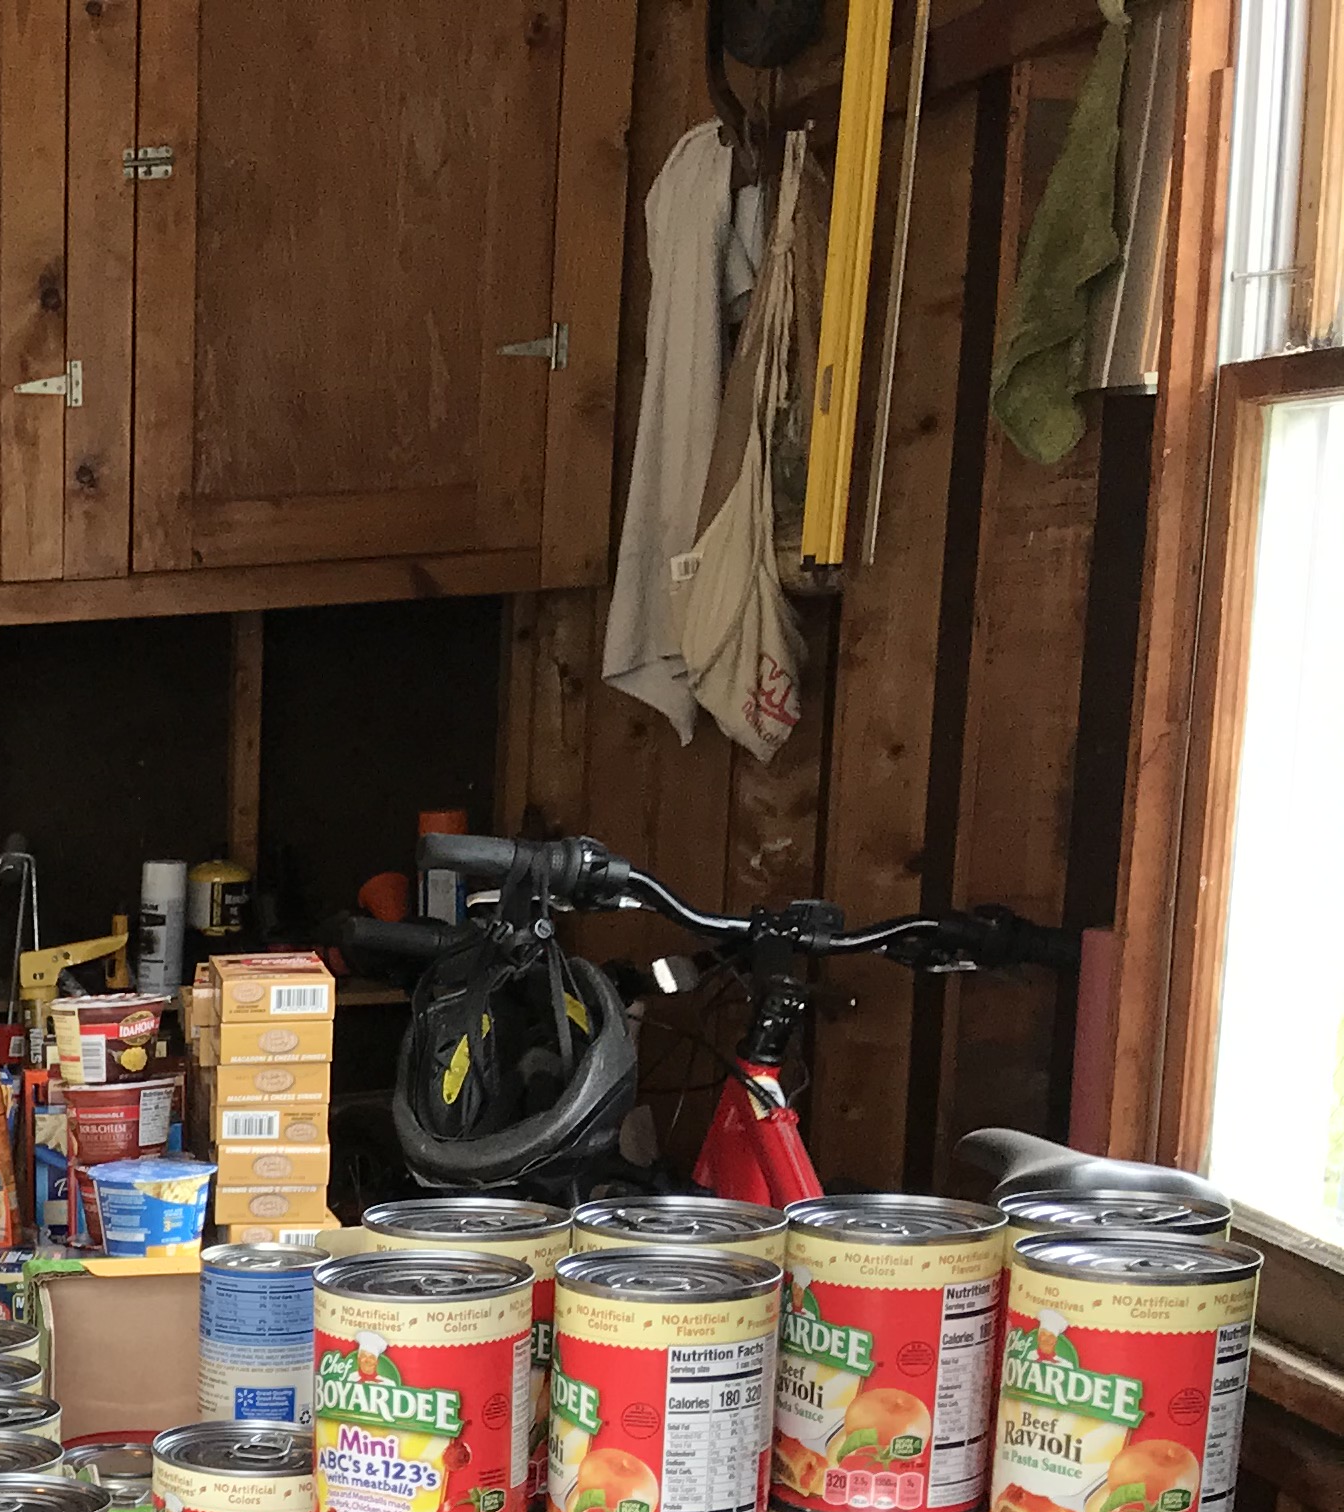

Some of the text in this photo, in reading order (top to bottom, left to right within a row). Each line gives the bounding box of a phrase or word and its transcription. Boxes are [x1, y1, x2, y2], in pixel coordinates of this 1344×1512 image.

[119, 1018, 158, 1038] IDAHOAN
[29, 1028, 44, 1064] NAILS
[231, 1055, 265, 1063] MACARONI
[427, 1307, 491, 1322] NO Artificial
[444, 1322, 477, 1333] Colors
[671, 1342, 764, 1362] Nutrition Facts
[320, 1352, 354, 1380] Chef
[316, 1372, 460, 1432] BOYARDEE
[1022, 1411, 1058, 1433] Beef
[340, 1428, 395, 1460] Mini
[1004, 1422, 1083, 1465] Ravioli
[319, 1457, 436, 1487] ABC's & 123's
